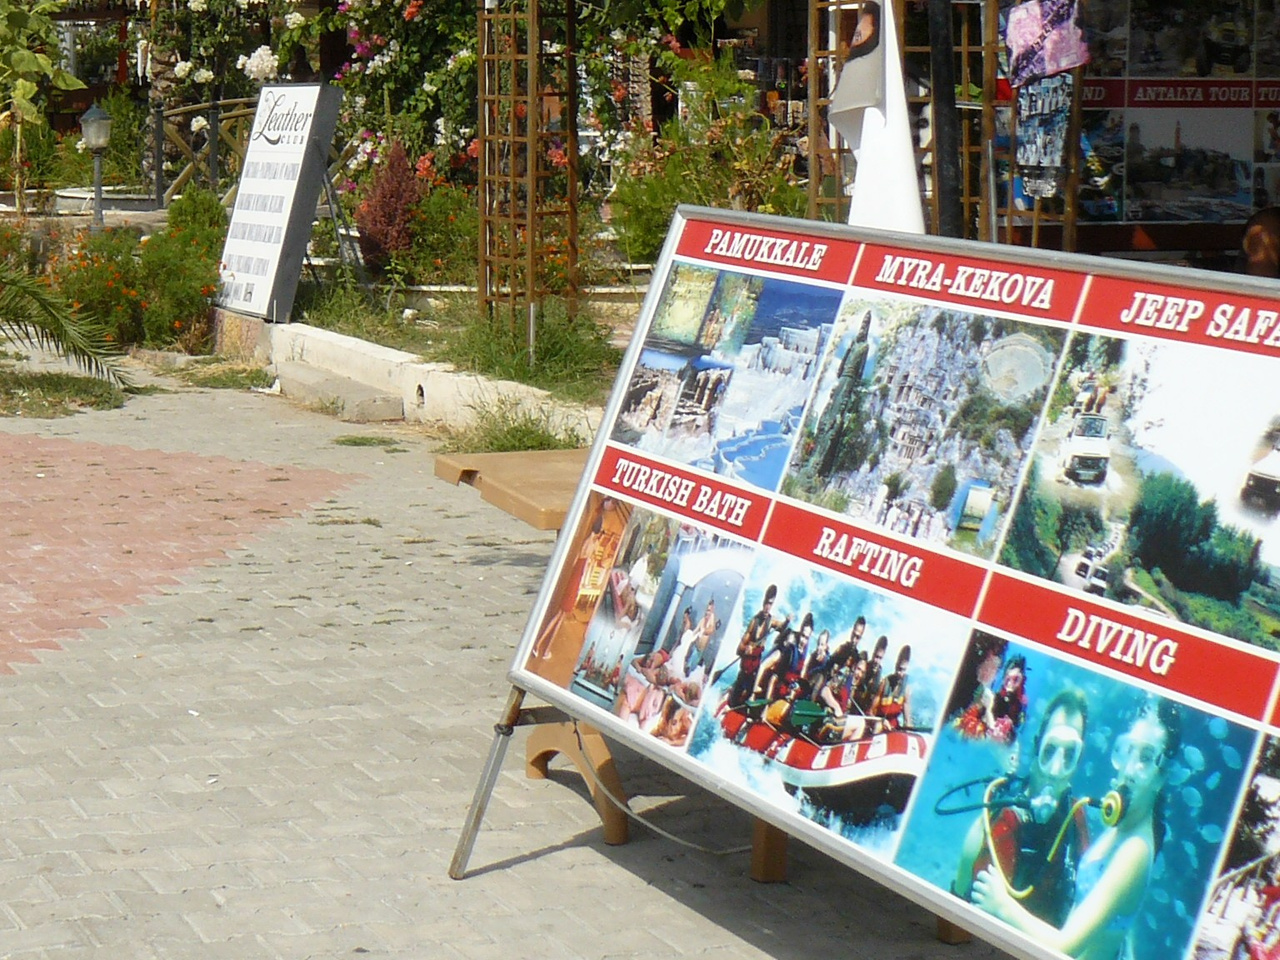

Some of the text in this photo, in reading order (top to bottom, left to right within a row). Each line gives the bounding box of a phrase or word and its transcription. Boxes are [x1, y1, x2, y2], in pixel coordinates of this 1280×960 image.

[252, 90, 313, 146] Leather
[1133, 86, 1251, 102] ANTALYA TOUR
[704, 228, 828, 271] PAMUKKALE
[875, 254, 1055, 310] MYRA-KEKOVA
[1120, 291, 1205, 332] JEEP
[611, 457, 752, 527] TURKISH BATH
[812, 526, 924, 588] RAFTING
[1056, 607, 1179, 676] DIVING
